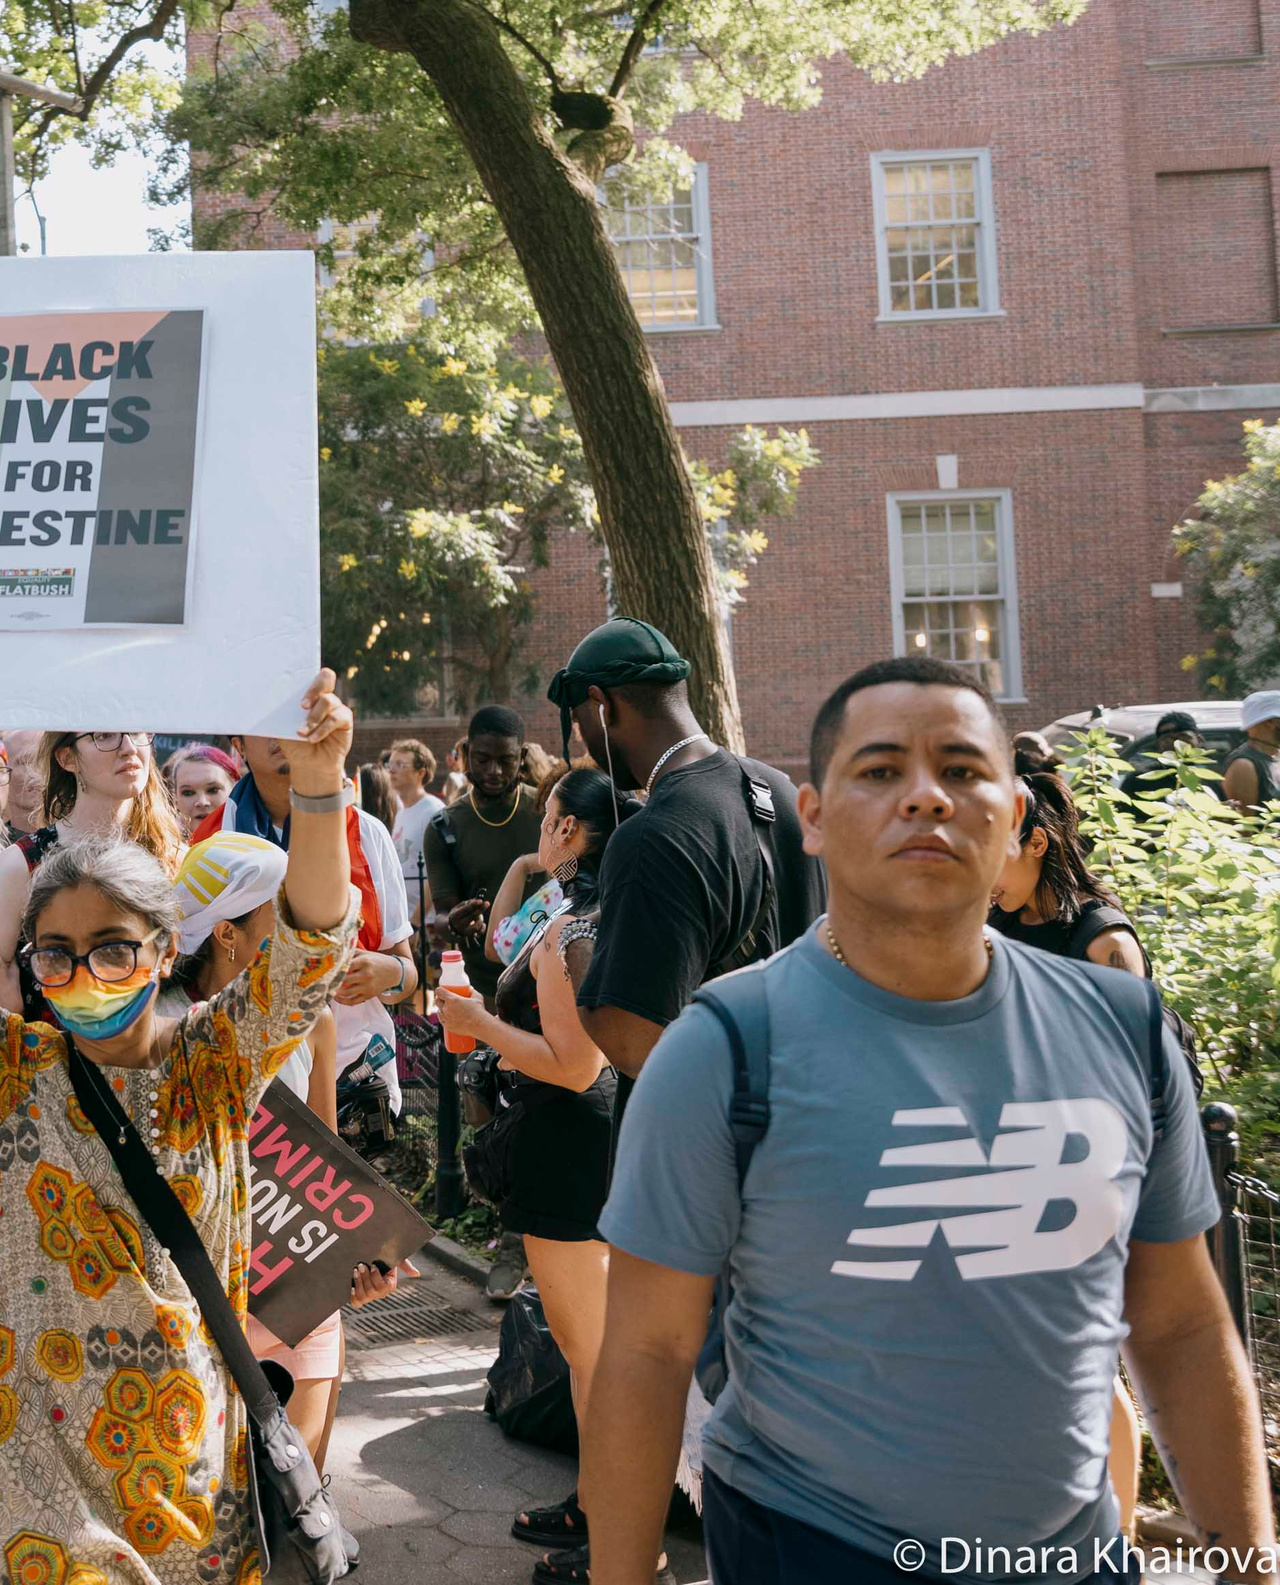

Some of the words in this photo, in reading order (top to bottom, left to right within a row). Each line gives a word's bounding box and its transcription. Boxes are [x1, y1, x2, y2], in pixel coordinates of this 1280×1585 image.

[4, 460, 93, 493] FOR
[249, 1165, 303, 1235] NO
[288, 1219, 340, 1264] IS
